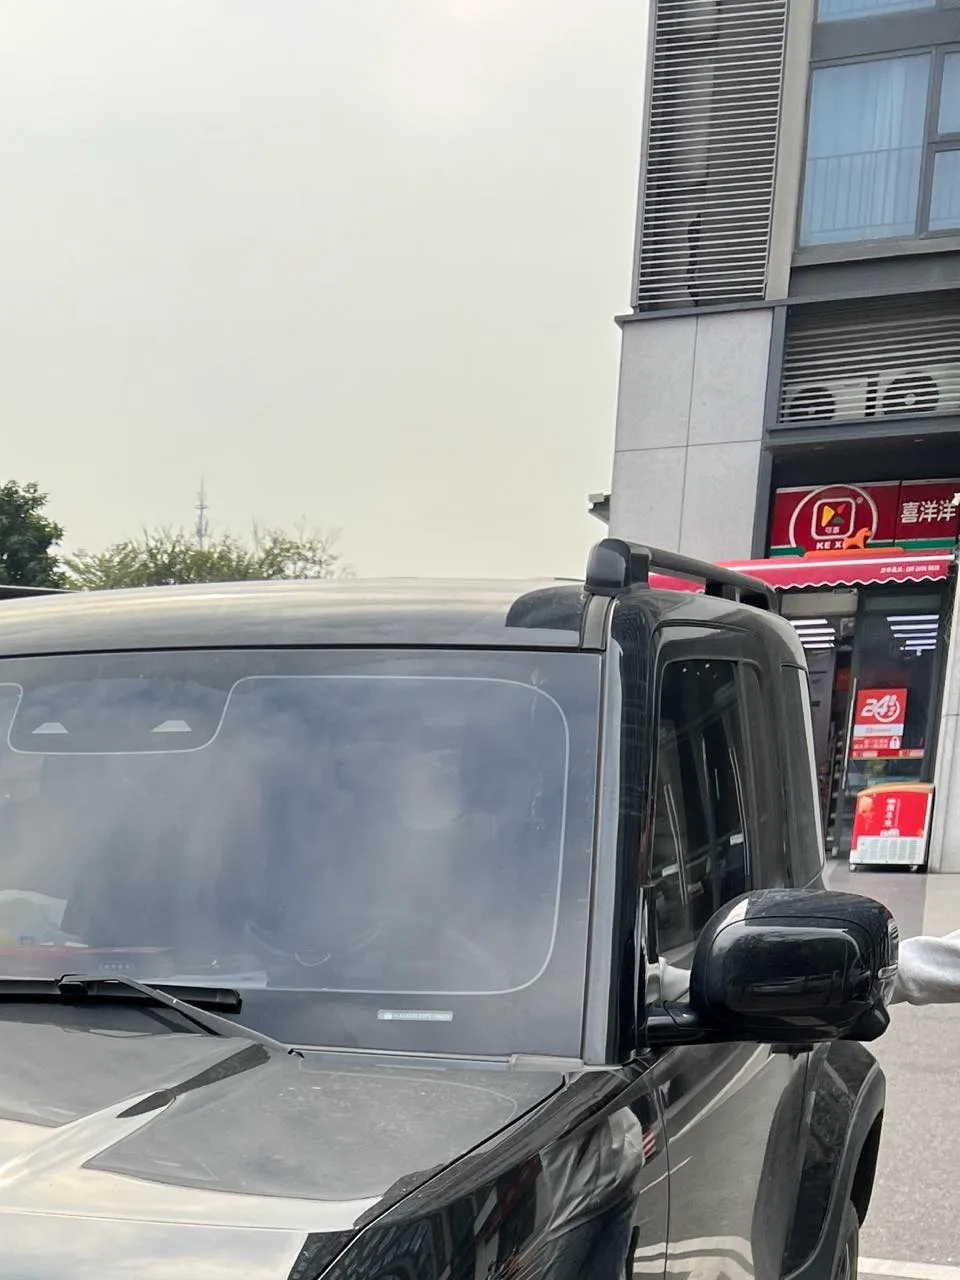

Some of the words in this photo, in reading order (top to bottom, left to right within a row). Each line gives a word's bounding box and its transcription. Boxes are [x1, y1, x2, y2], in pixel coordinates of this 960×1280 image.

[901, 500, 956, 523] 喜洋洋
[816, 541, 831, 550] KE
